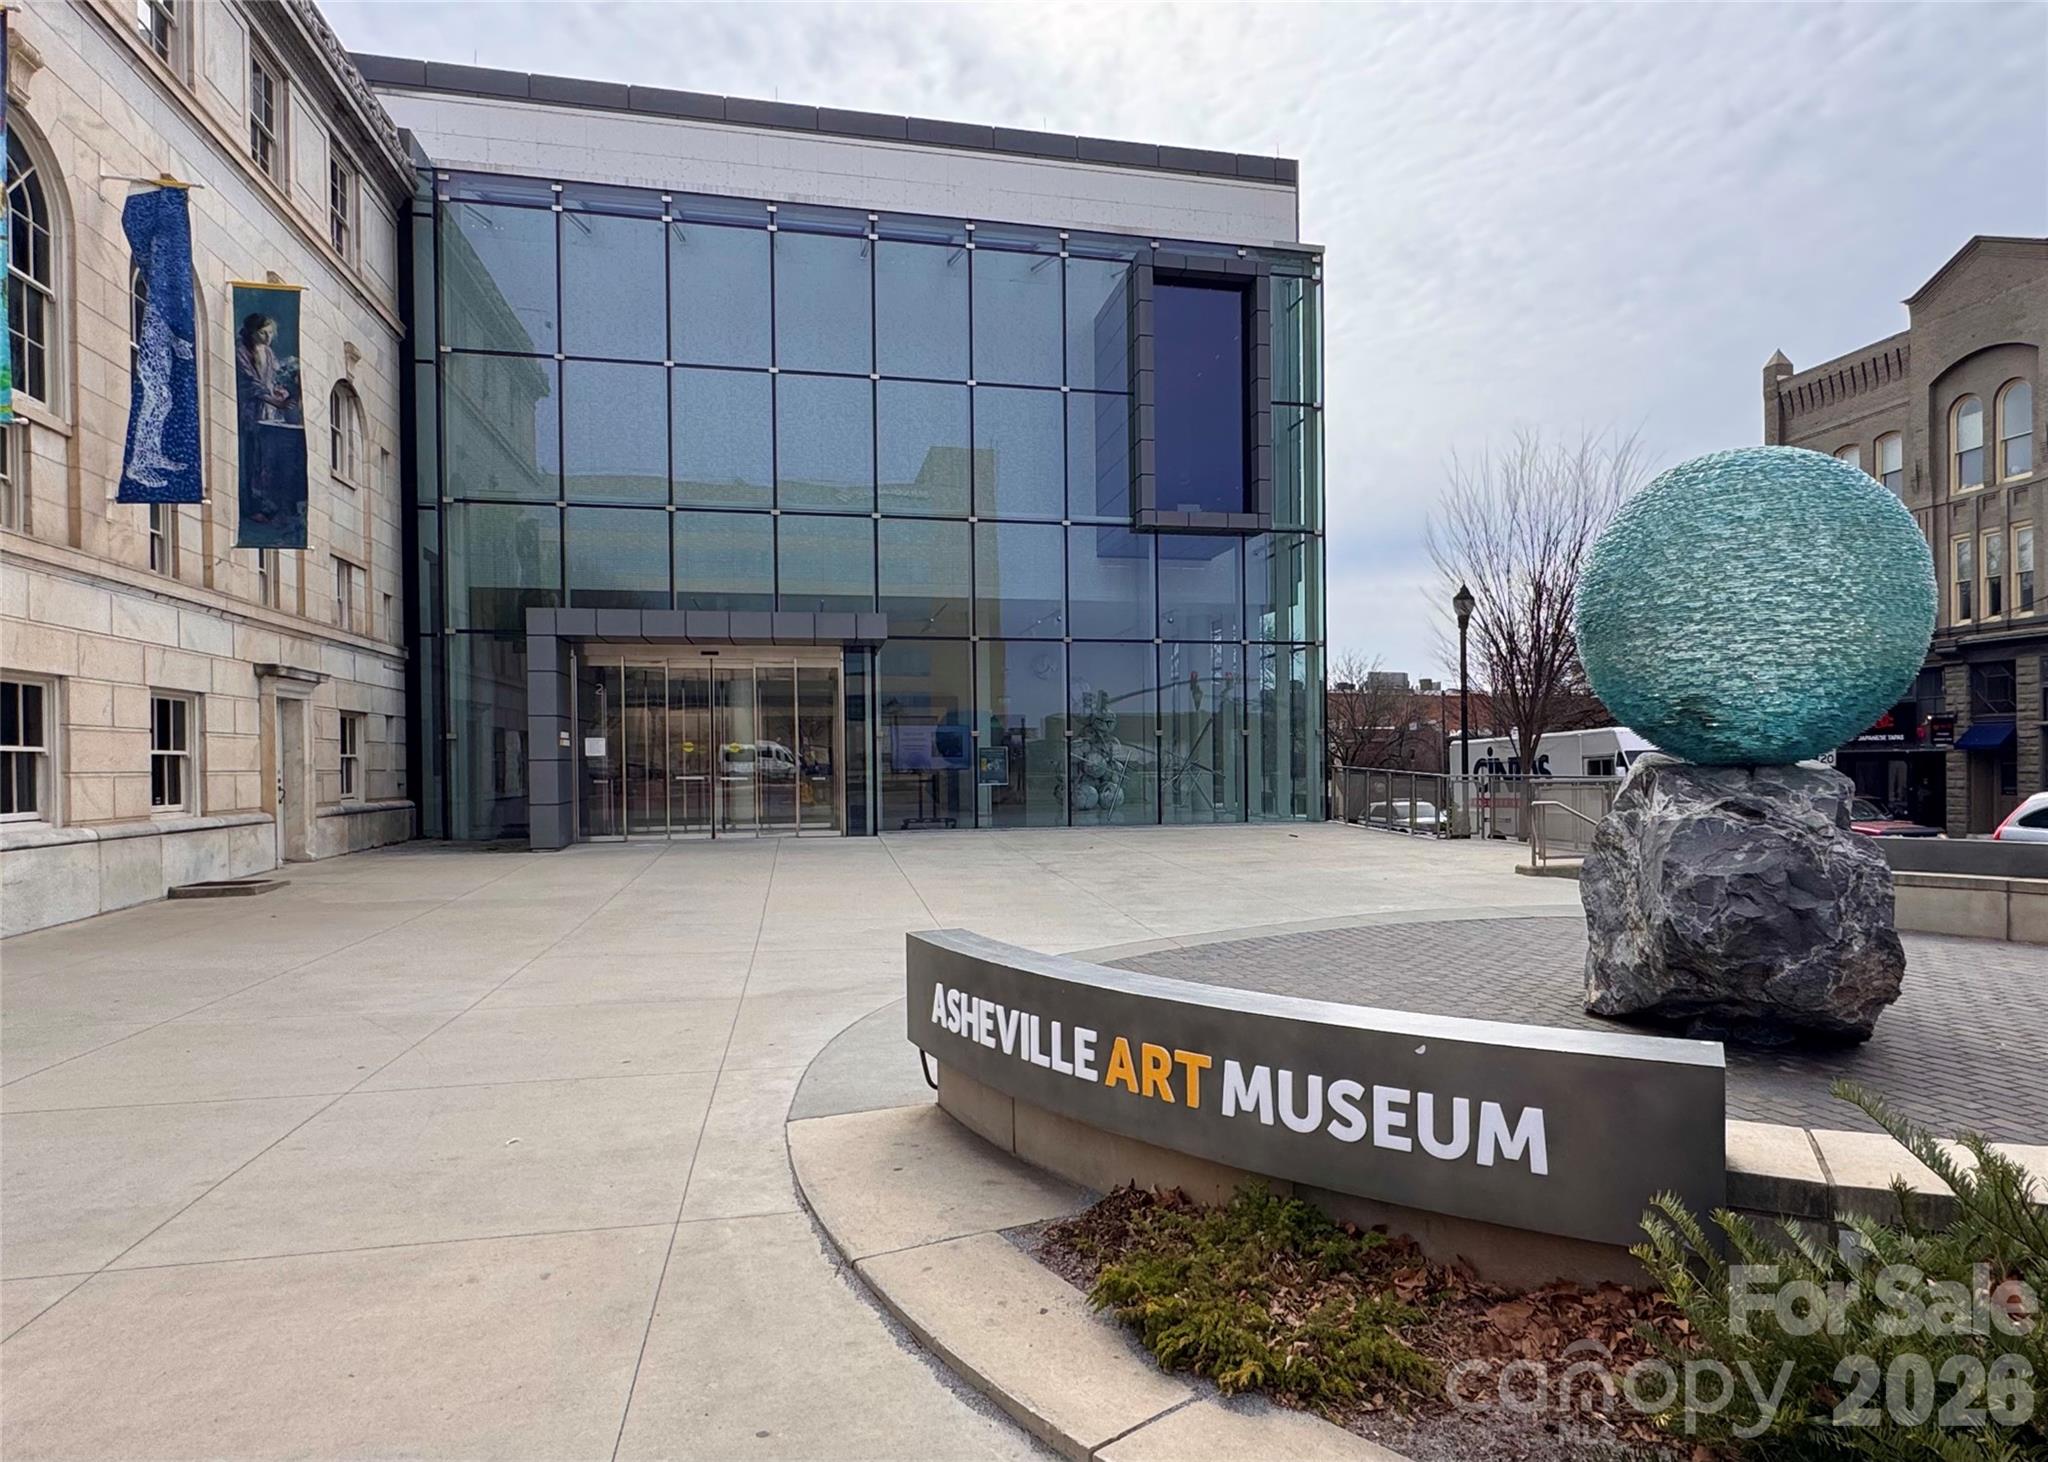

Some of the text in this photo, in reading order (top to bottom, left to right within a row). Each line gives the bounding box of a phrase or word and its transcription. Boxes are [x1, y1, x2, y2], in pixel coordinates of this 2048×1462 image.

[1820, 754, 1834, 764] 20
[931, 982, 1549, 1176] ASHEVILLE ART MUSEUM
